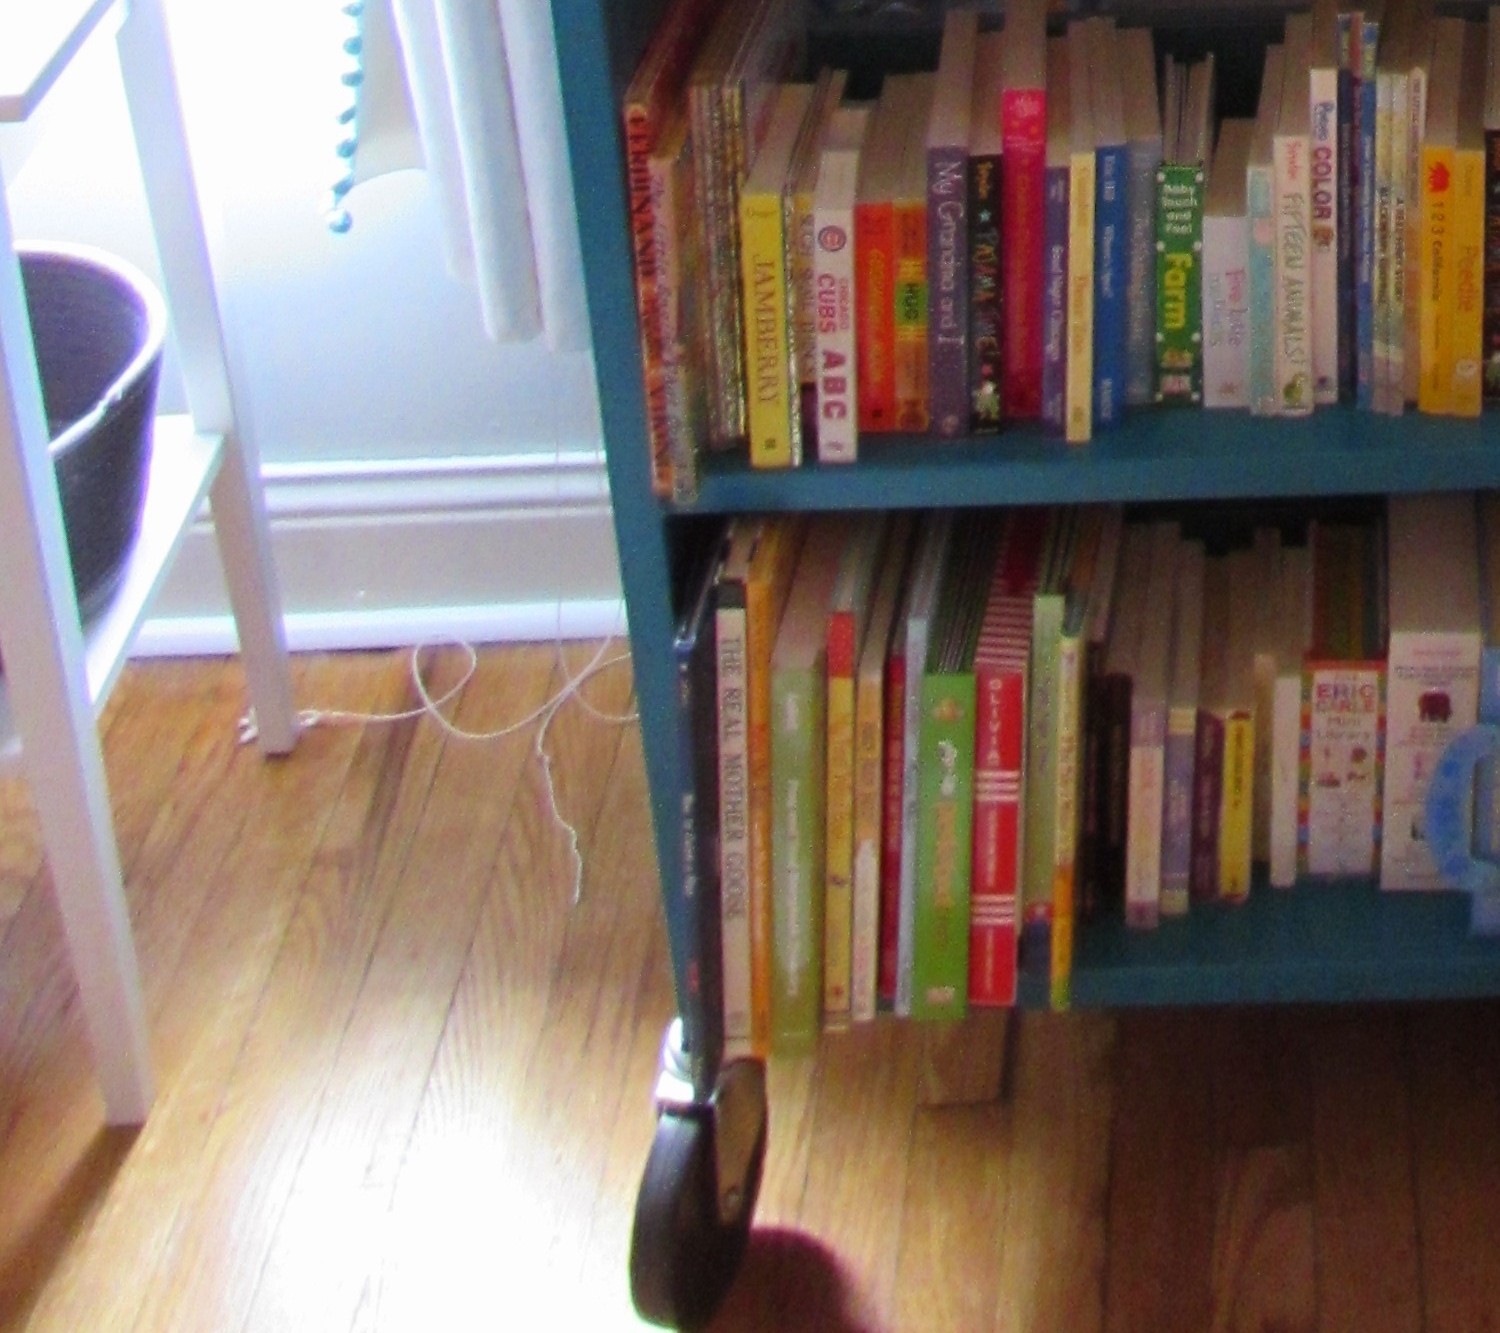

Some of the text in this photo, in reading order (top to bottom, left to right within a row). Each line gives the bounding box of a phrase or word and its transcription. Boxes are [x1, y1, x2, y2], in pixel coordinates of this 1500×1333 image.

[932, 161, 964, 195] My
[1311, 146, 1333, 220] COLOR
[936, 201, 965, 292] Grandma
[817, 273, 838, 334] CUBS
[939, 295, 959, 330] and
[1163, 252, 1194, 331] Farm
[752, 253, 780, 407] JAMBERRY
[722, 638, 743, 676] THE
[723, 686, 744, 740] REAL
[723, 752, 745, 841] MOTHER
